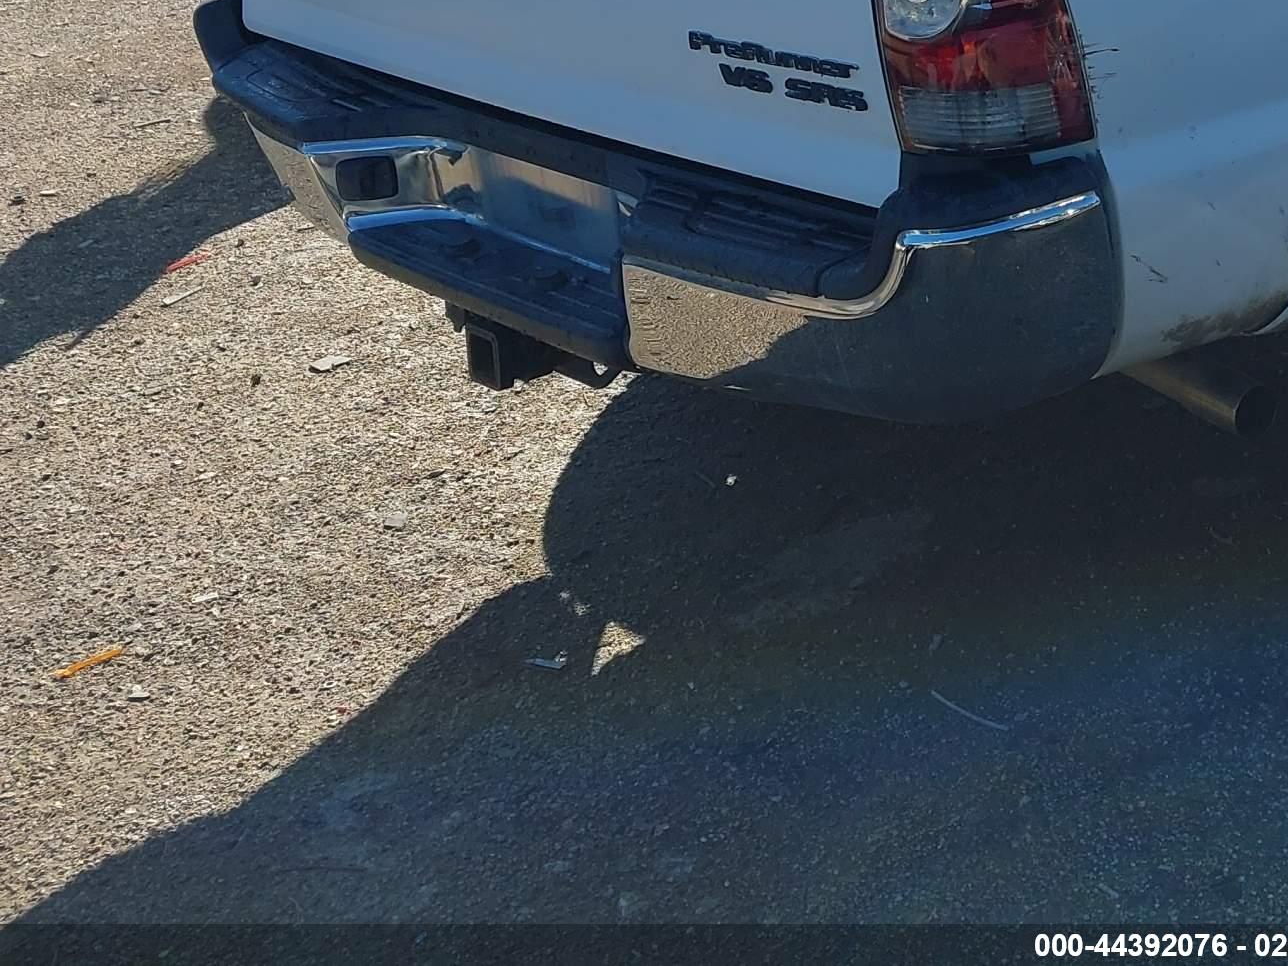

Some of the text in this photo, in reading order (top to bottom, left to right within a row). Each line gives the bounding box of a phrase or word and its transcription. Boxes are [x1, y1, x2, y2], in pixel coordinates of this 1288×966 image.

[688, 30, 860, 79] PreRunner
[718, 63, 869, 112] V6 SR5
